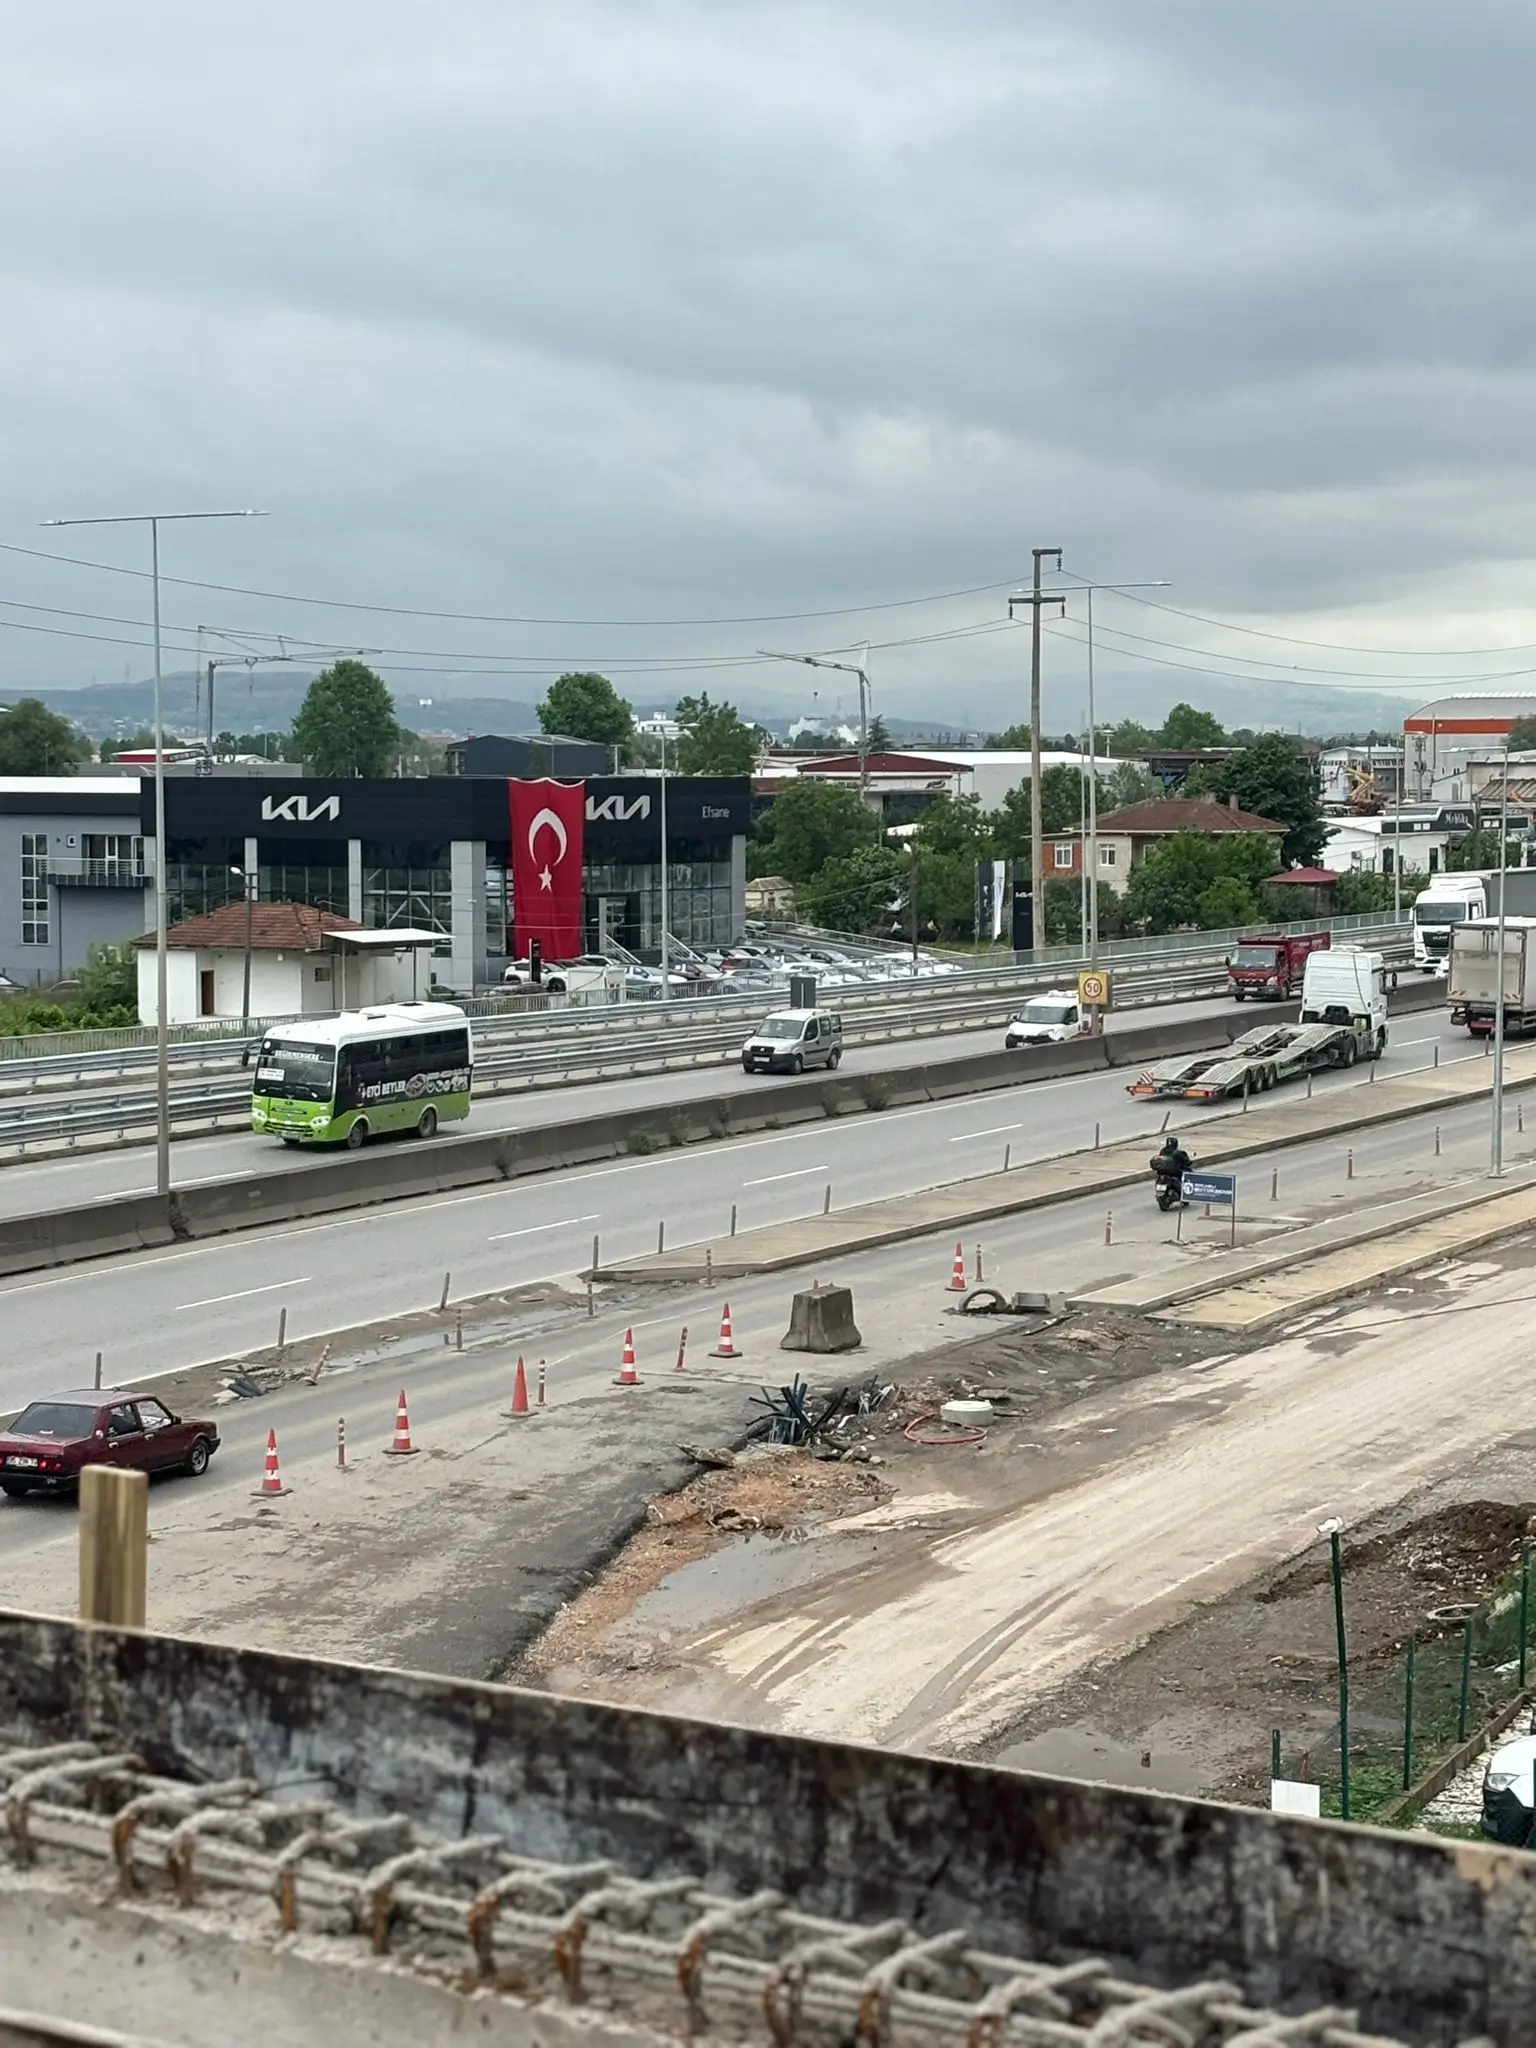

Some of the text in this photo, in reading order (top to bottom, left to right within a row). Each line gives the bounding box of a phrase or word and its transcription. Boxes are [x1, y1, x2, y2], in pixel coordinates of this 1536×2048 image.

[262, 795, 340, 821] KIA
[585, 795, 651, 820] KIA
[702, 806, 730, 819] Efsane
[1087, 982, 1099, 993] 50
